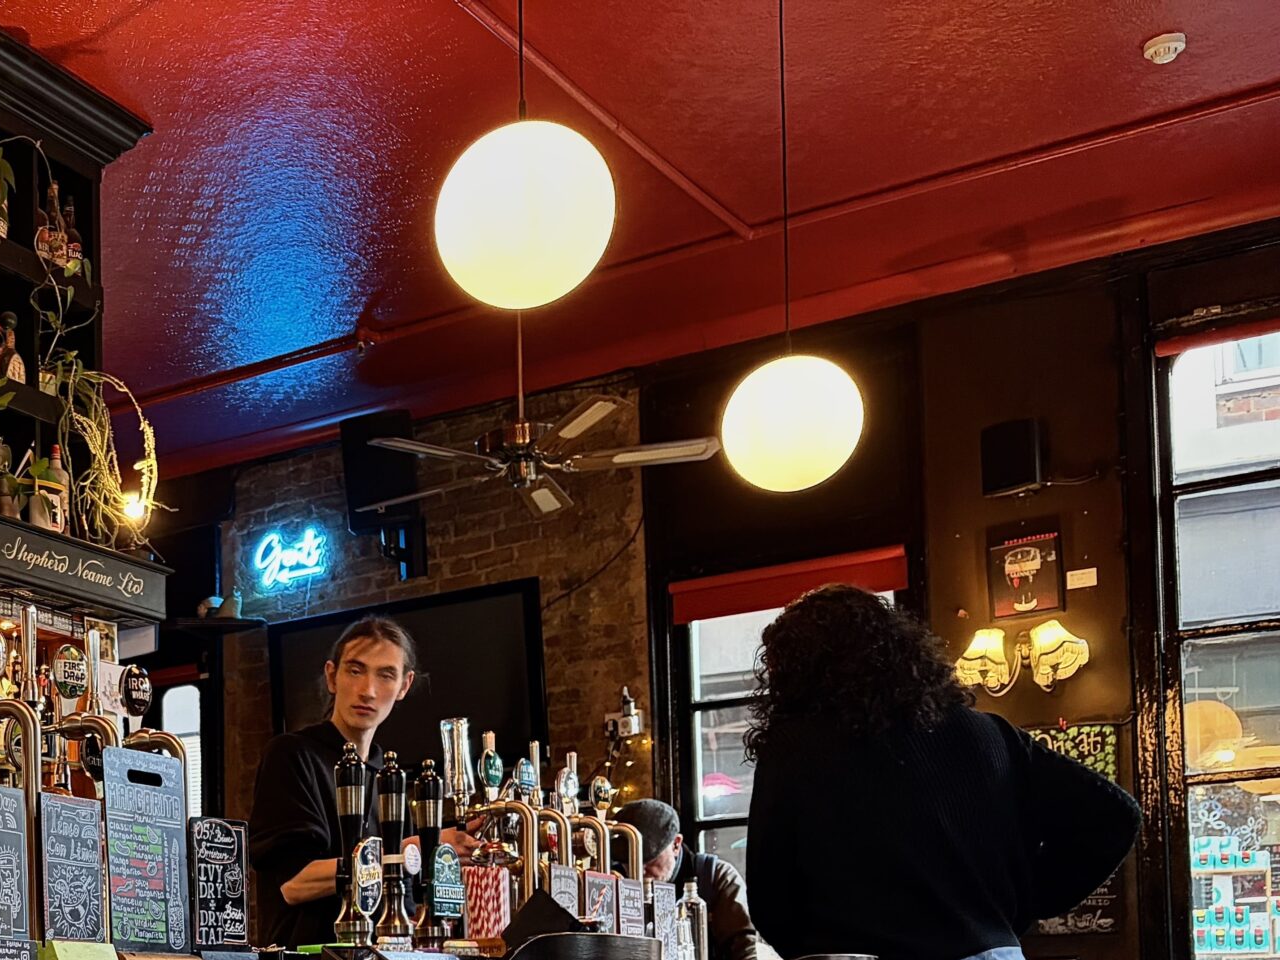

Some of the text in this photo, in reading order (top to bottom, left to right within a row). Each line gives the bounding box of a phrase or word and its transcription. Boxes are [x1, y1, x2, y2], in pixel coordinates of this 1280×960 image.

[1, 536, 69, 573] Shepherd
[68, 559, 114, 587] Neame
[1075, 732, 1102, 755] at
[107, 782, 181, 820] MARGARITA
[199, 863, 223, 882] IVY
[199, 882, 223, 898] DRY
[436, 886, 465, 899] CREEKSIDE
[200, 910, 223, 926] DRY
[200, 928, 224, 945] TAI
